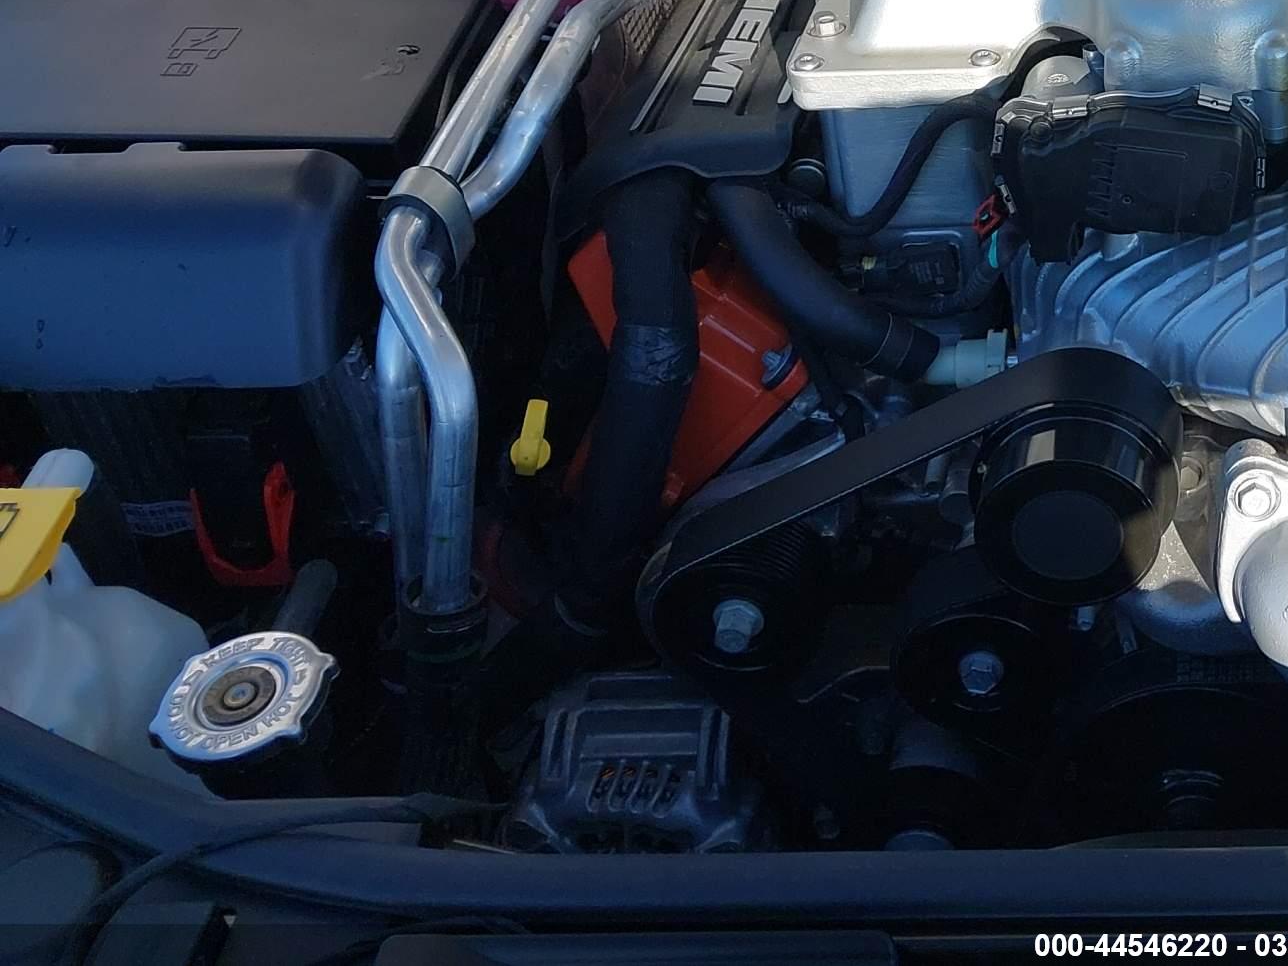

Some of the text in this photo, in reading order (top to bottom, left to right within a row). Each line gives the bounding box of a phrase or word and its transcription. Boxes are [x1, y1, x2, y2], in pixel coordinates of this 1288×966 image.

[200, 636, 265, 669] KEEP
[201, 723, 260, 751] OPEN
[262, 691, 301, 730] HOT
